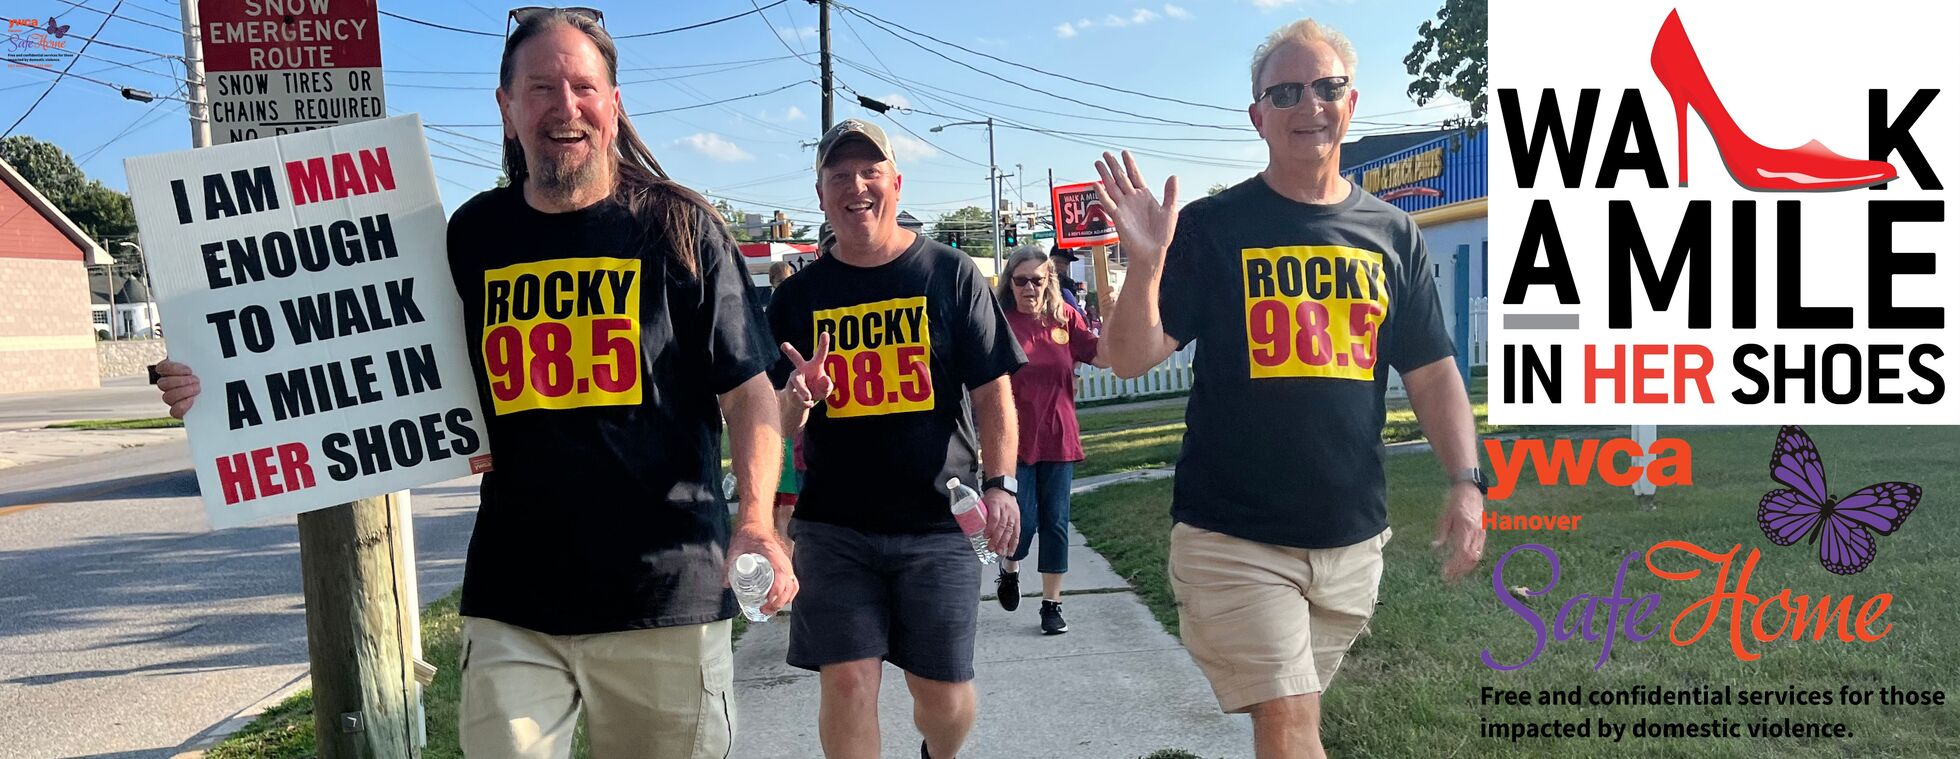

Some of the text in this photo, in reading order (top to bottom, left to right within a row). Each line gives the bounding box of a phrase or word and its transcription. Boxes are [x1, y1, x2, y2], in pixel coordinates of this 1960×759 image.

[210, 19, 367, 44] EMERGENCY
[245, 0, 329, 17] SNOW
[218, 70, 372, 96] SNOW TIRES OR
[250, 46, 335, 69] ROUTE
[213, 96, 381, 123] CHAINS REQUIRED
[170, 146, 396, 225] I AM MAN
[1086, 192, 1098, 201] MIL
[200, 213, 399, 290] ENOUGH
[1246, 255, 1381, 301] ROCKY
[206, 277, 426, 359] TO WALK
[487, 269, 636, 326] ROCKY
[816, 305, 925, 352] ROCKY
[1250, 299, 1382, 370] 98.5
[225, 344, 442, 431] A MILE IN
[485, 318, 637, 402] 98.5
[825, 346, 933, 410] 98.5
[215, 407, 481, 505] HER SHOES
